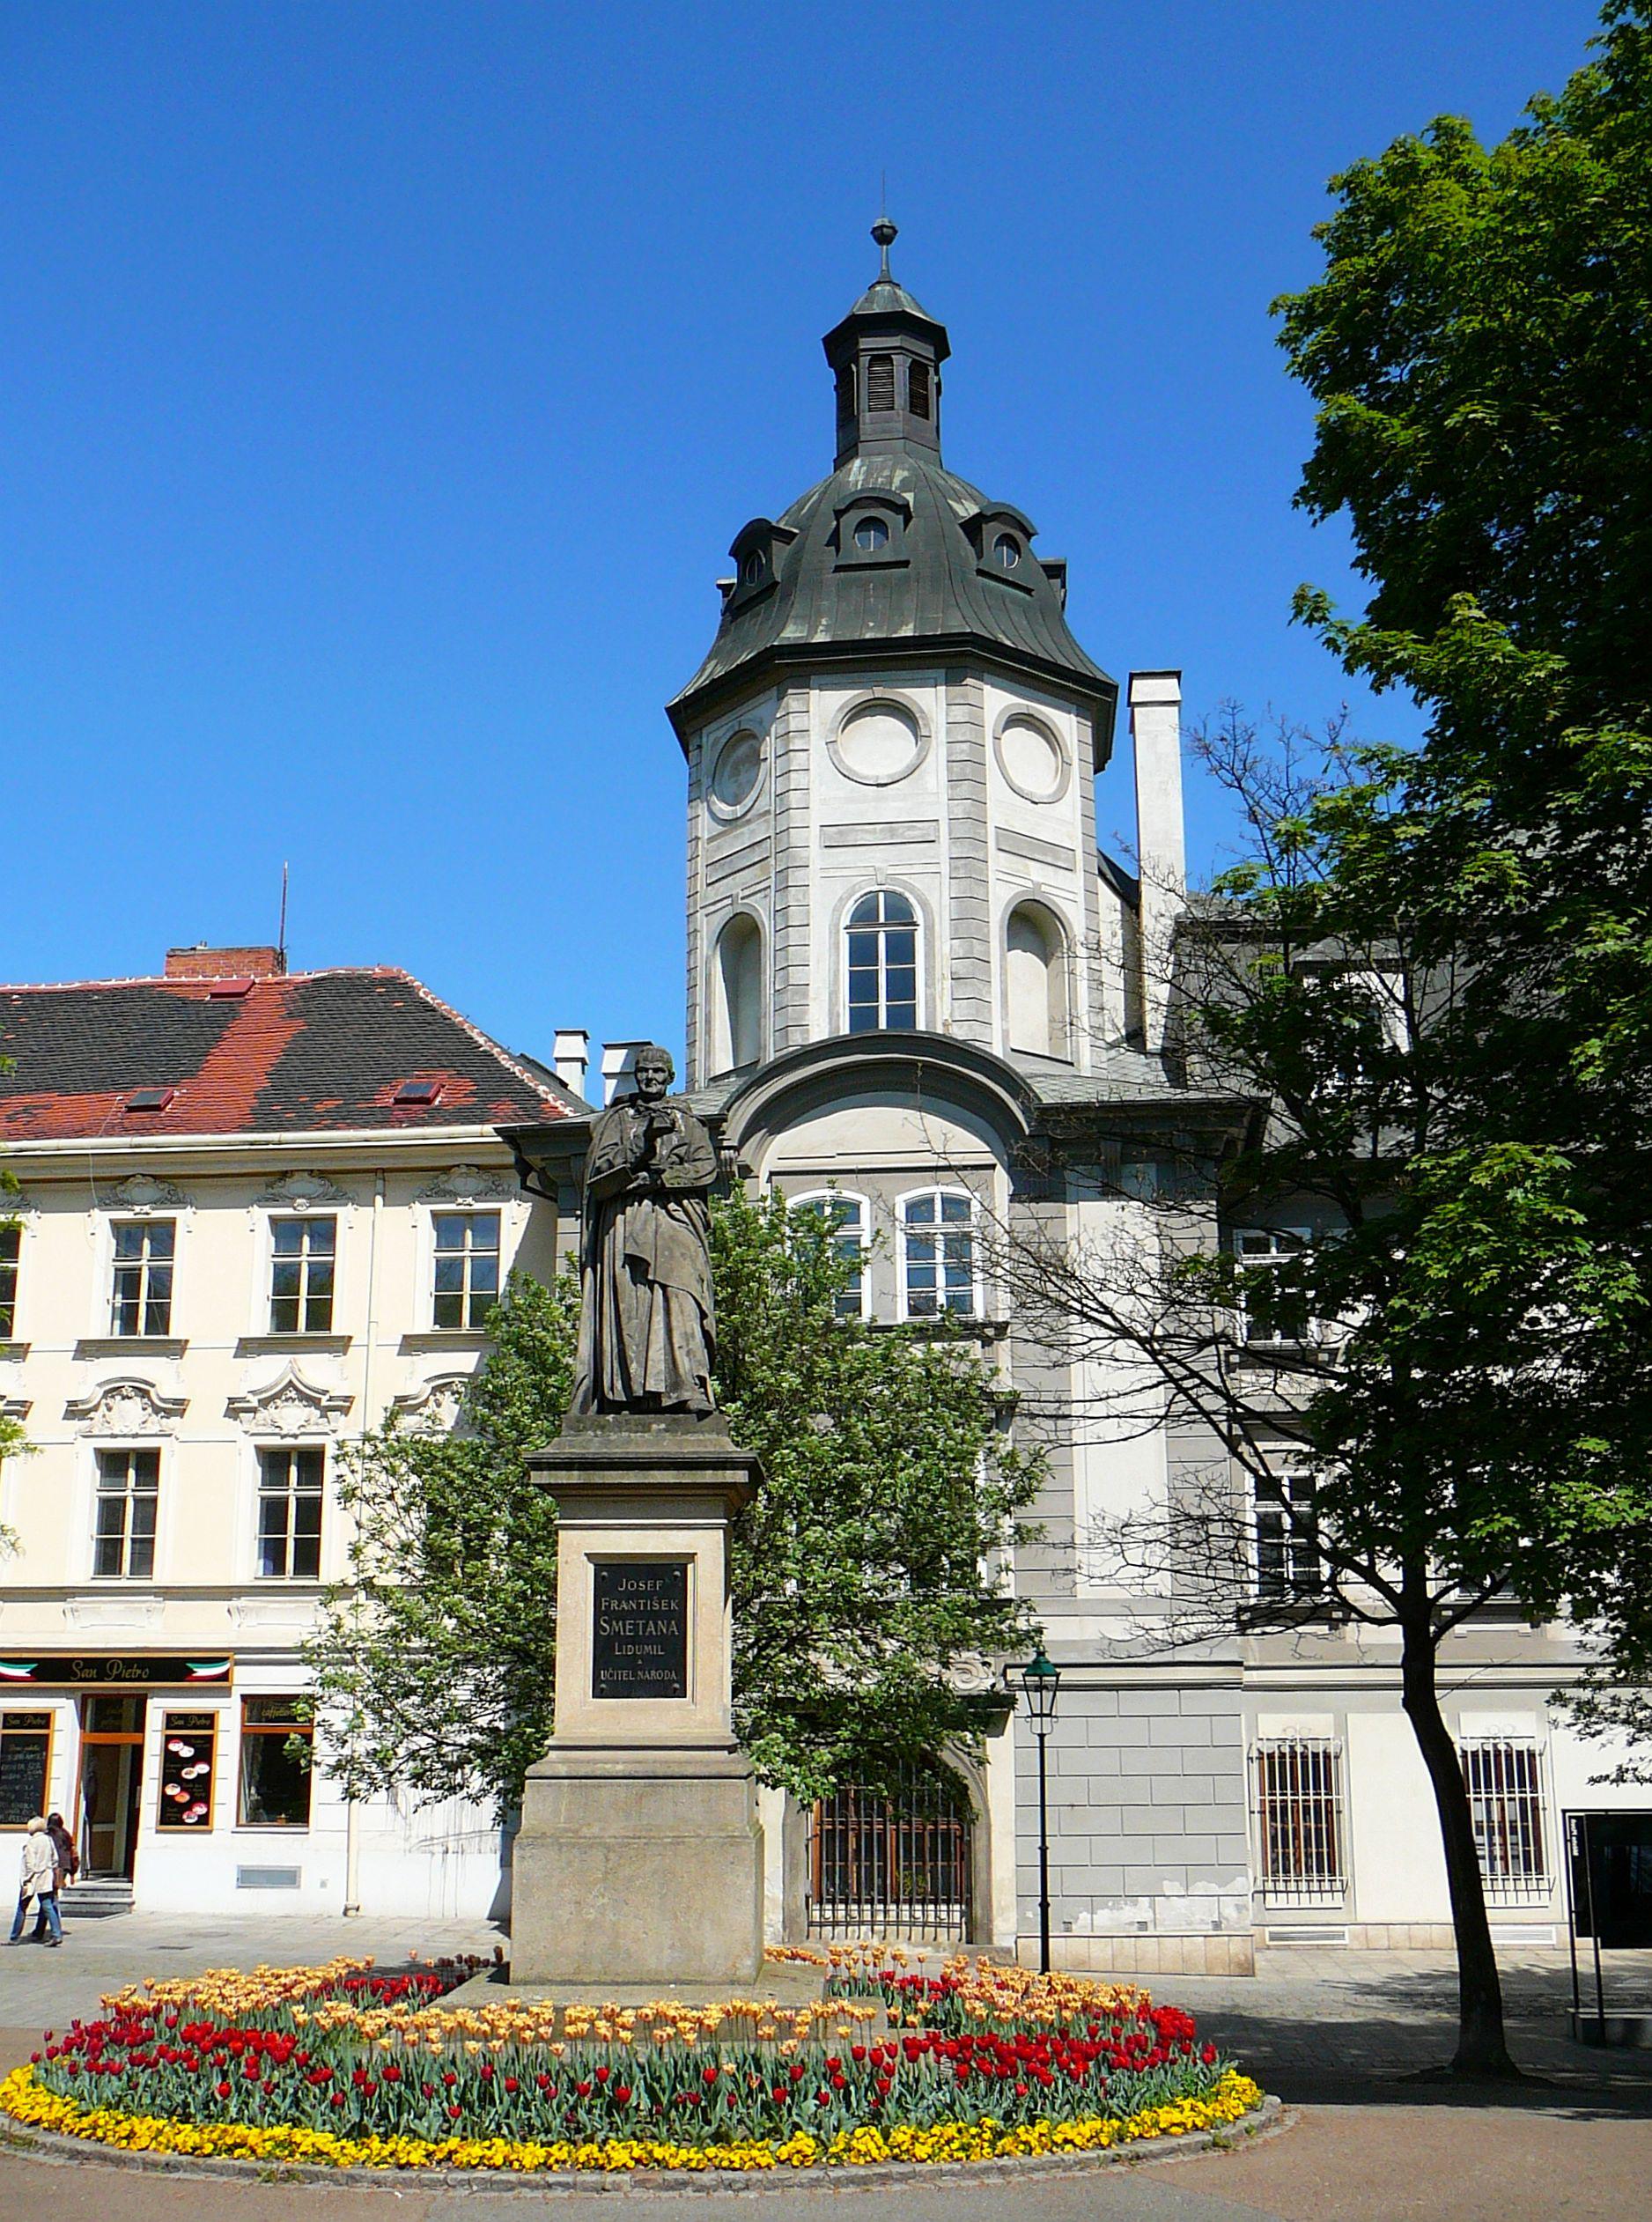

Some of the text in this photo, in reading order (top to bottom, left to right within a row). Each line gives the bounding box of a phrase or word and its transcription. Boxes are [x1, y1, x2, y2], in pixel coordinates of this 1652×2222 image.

[617, 1578, 664, 1591] JOSEF
[601, 1597, 679, 1611] FRANTIŠEK
[599, 1616, 679, 1635] SMETANA
[615, 1643, 666, 1656] LIDUMIL
[70, 1659, 150, 1681] San Pietro
[601, 1667, 635, 1680] UČITEL
